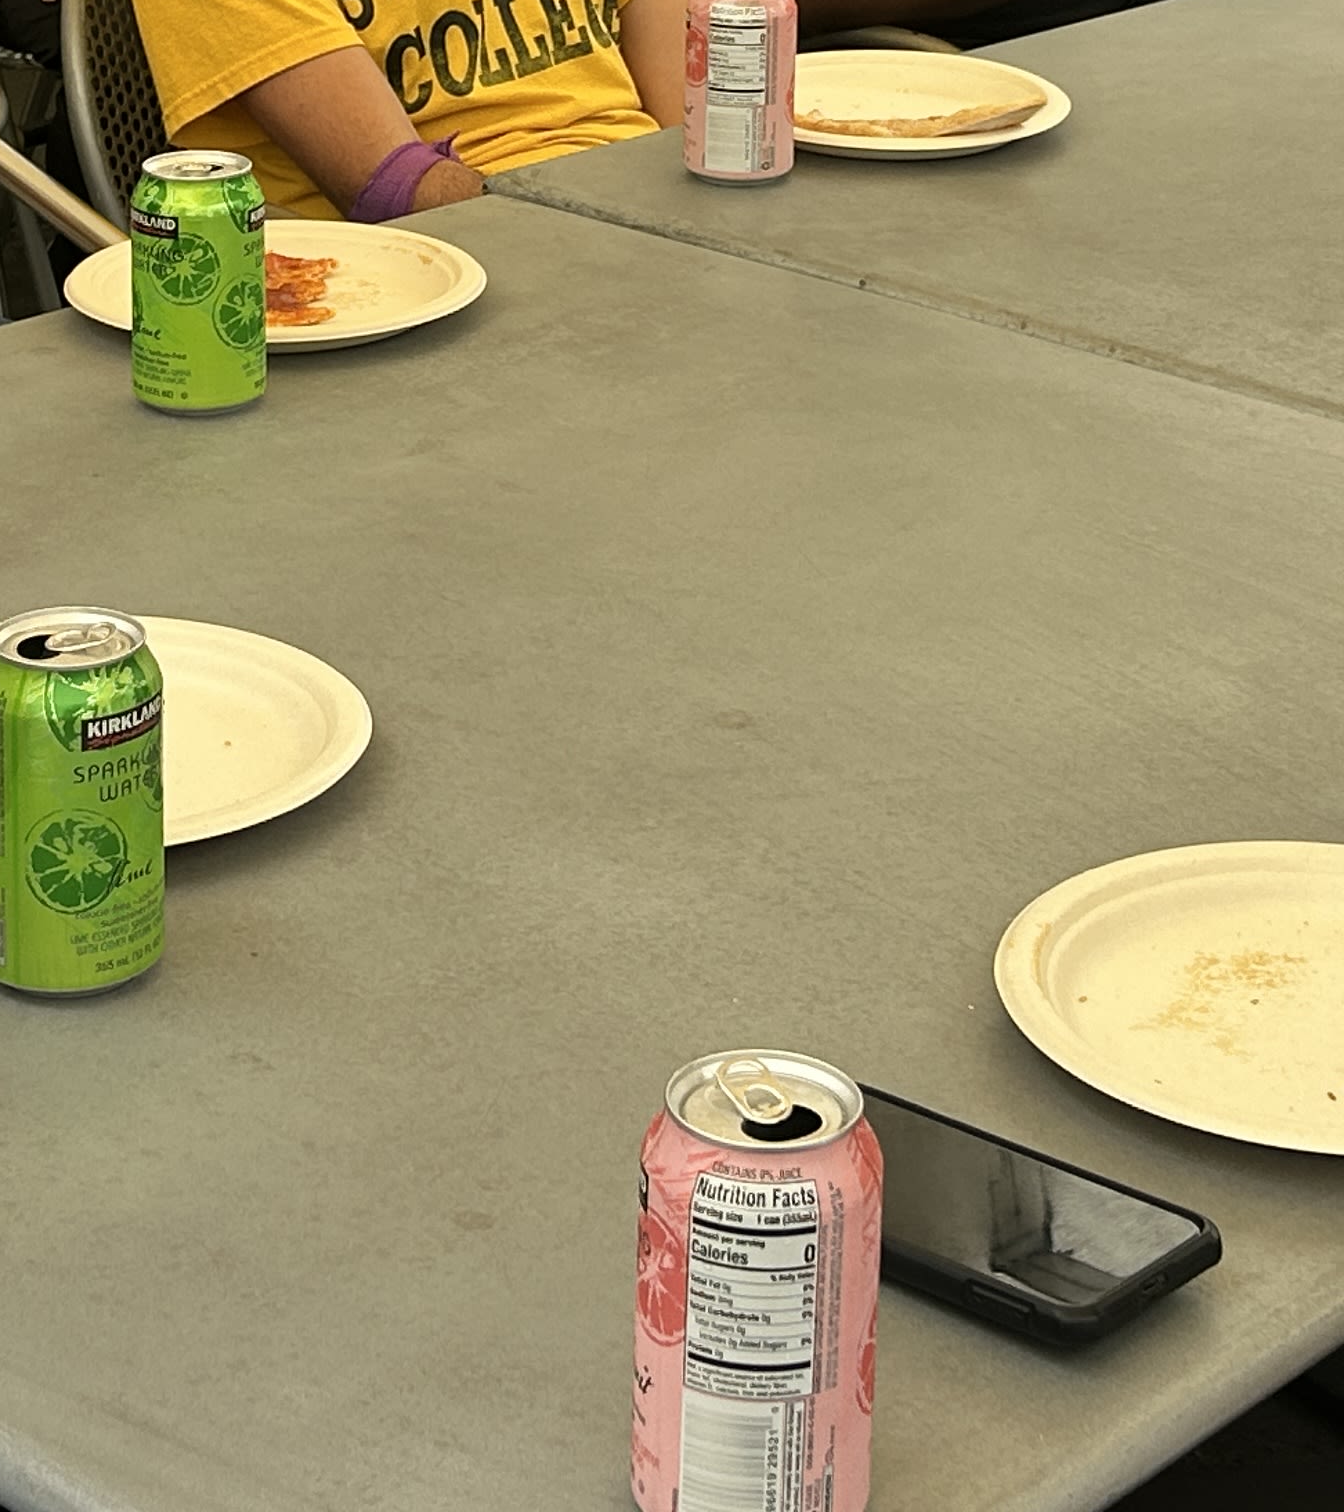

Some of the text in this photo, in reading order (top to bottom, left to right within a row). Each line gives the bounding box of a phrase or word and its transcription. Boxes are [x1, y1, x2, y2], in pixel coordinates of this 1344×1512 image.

[696, 1176, 816, 1208] Nutrition Facts
[691, 1238, 816, 1265] Calories 0
